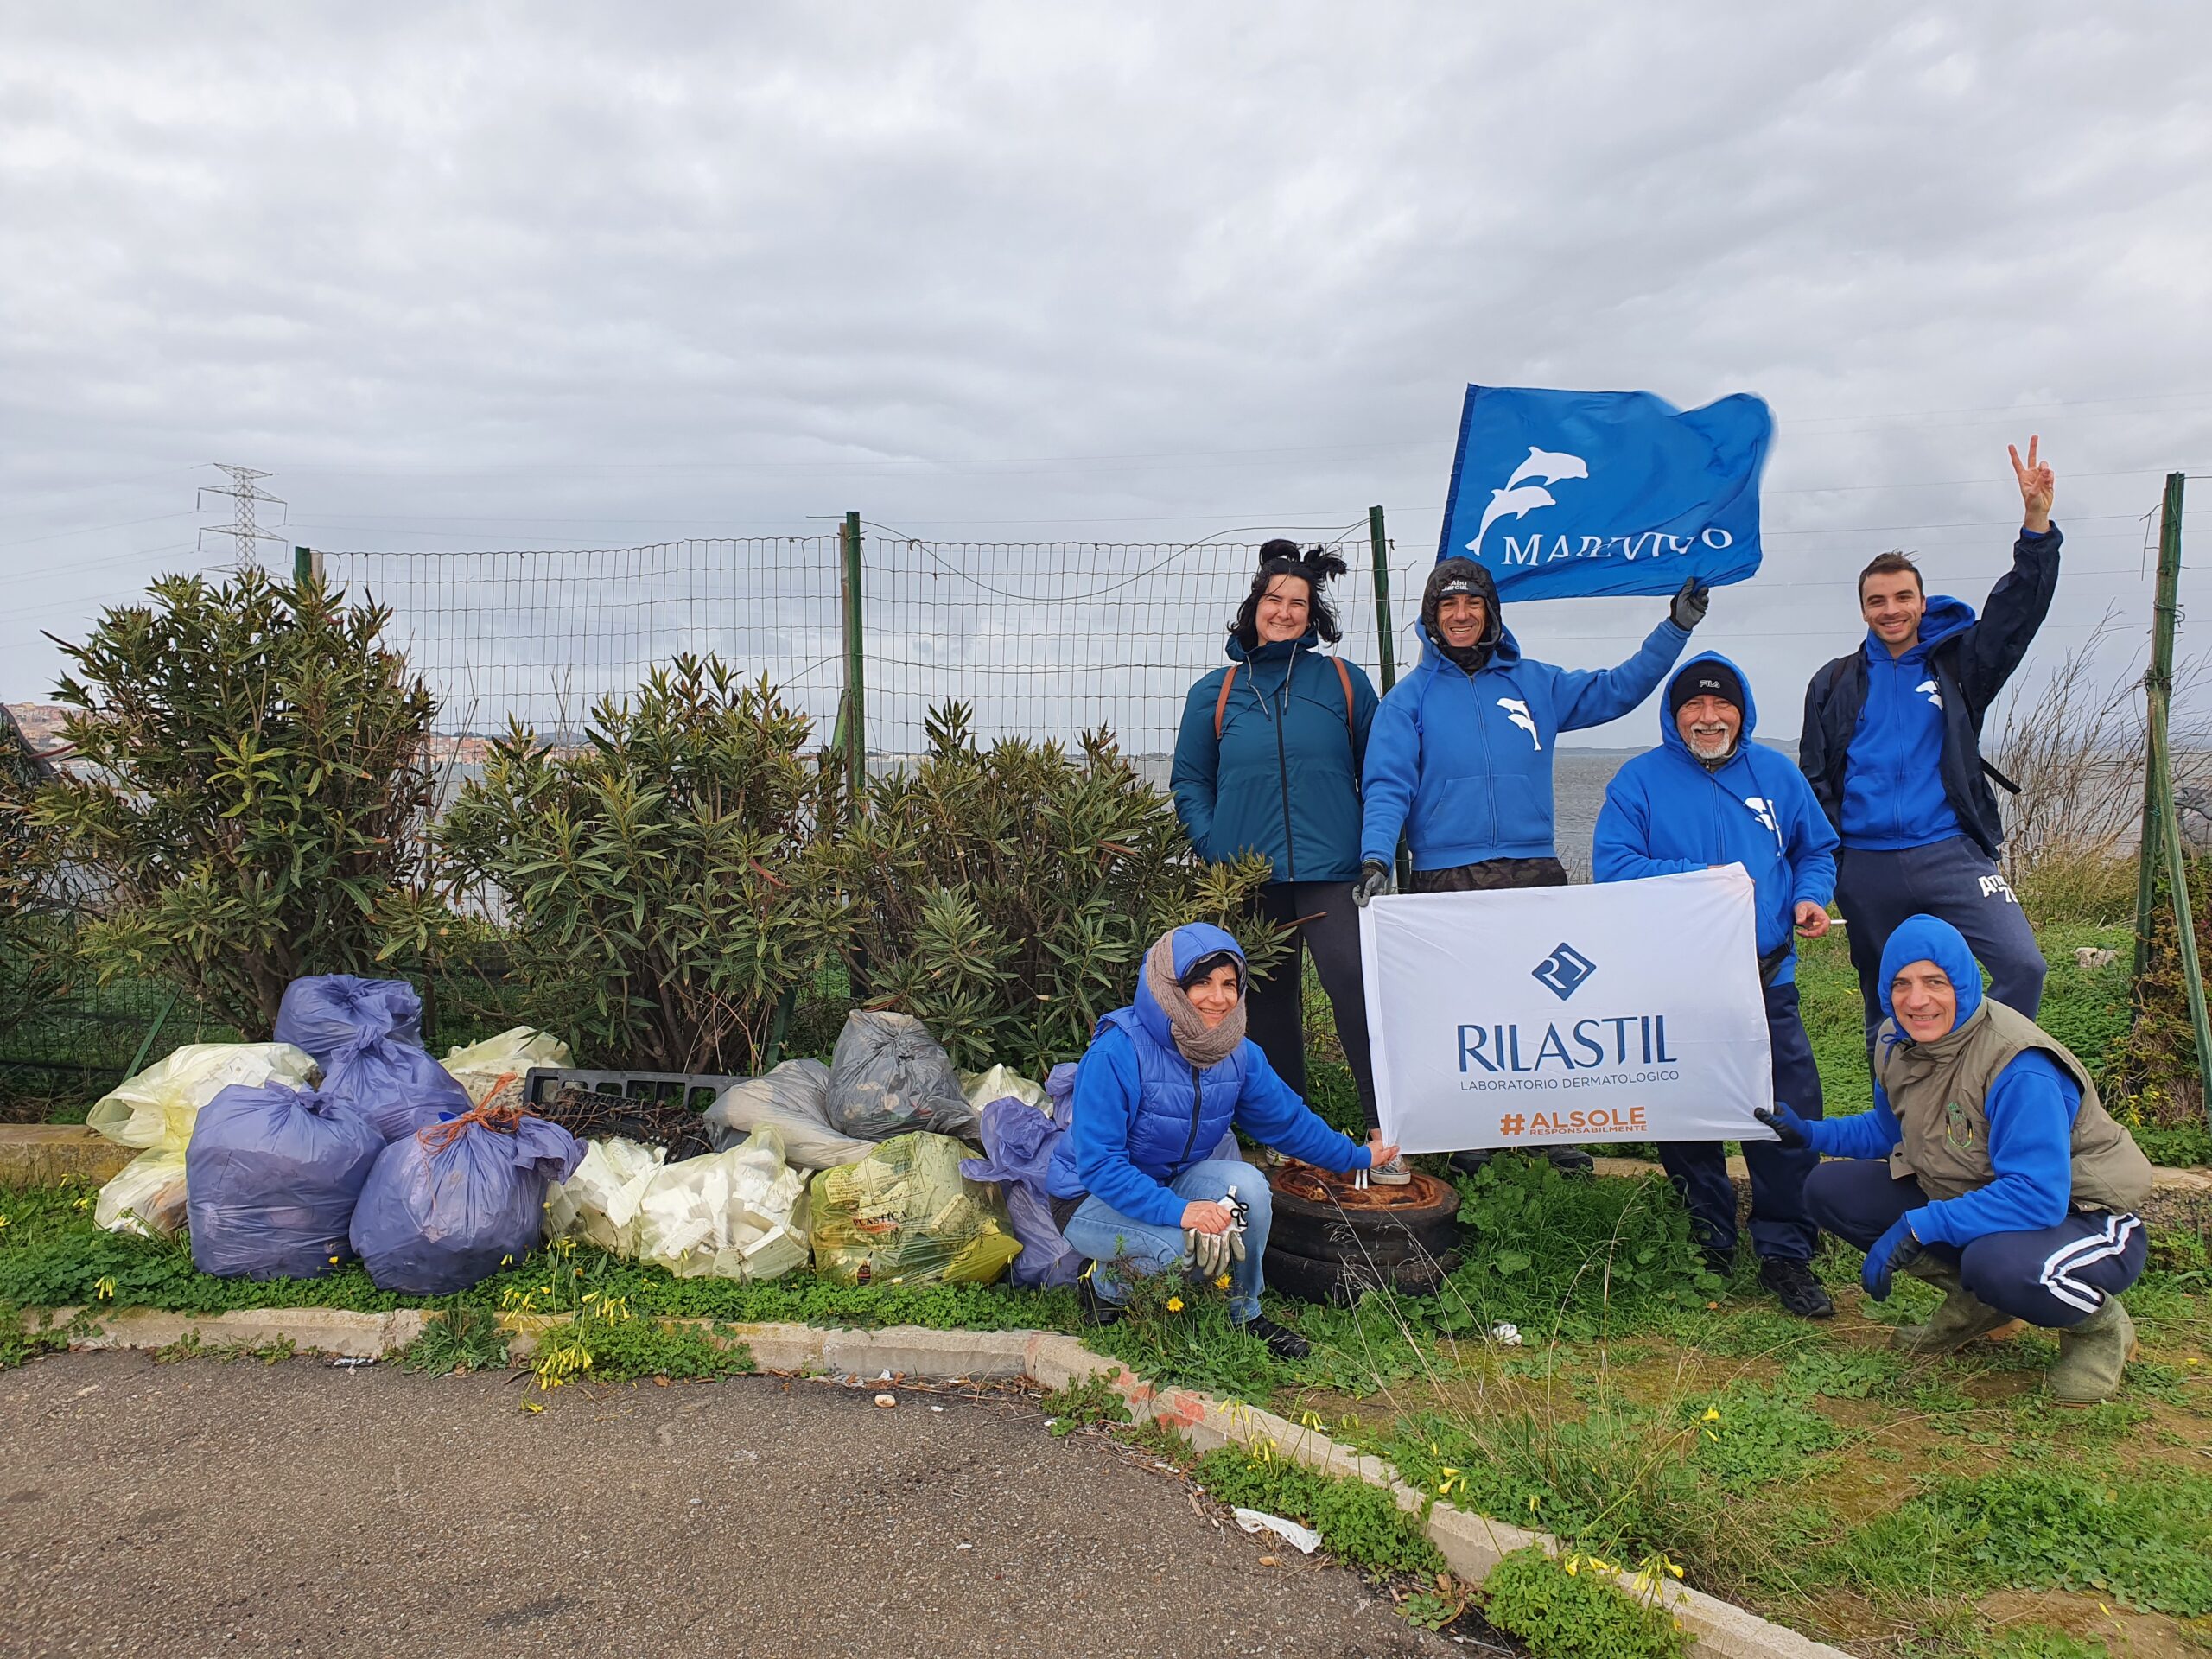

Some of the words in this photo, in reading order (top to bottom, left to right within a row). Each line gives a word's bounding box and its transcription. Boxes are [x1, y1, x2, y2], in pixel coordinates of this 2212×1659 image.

[1699, 679, 1721, 689] FILA
[1457, 1014, 1678, 1072] RILASTIL
[1460, 1078, 1558, 1091] LABORATORIO
[1562, 1070, 1680, 1090] DERMATOLOGICO
[1500, 1106, 1647, 1136] #ALSOLE
[1529, 1124, 1648, 1135] RESPONSABILMENTE
[852, 1210, 908, 1226] PLASTICA
